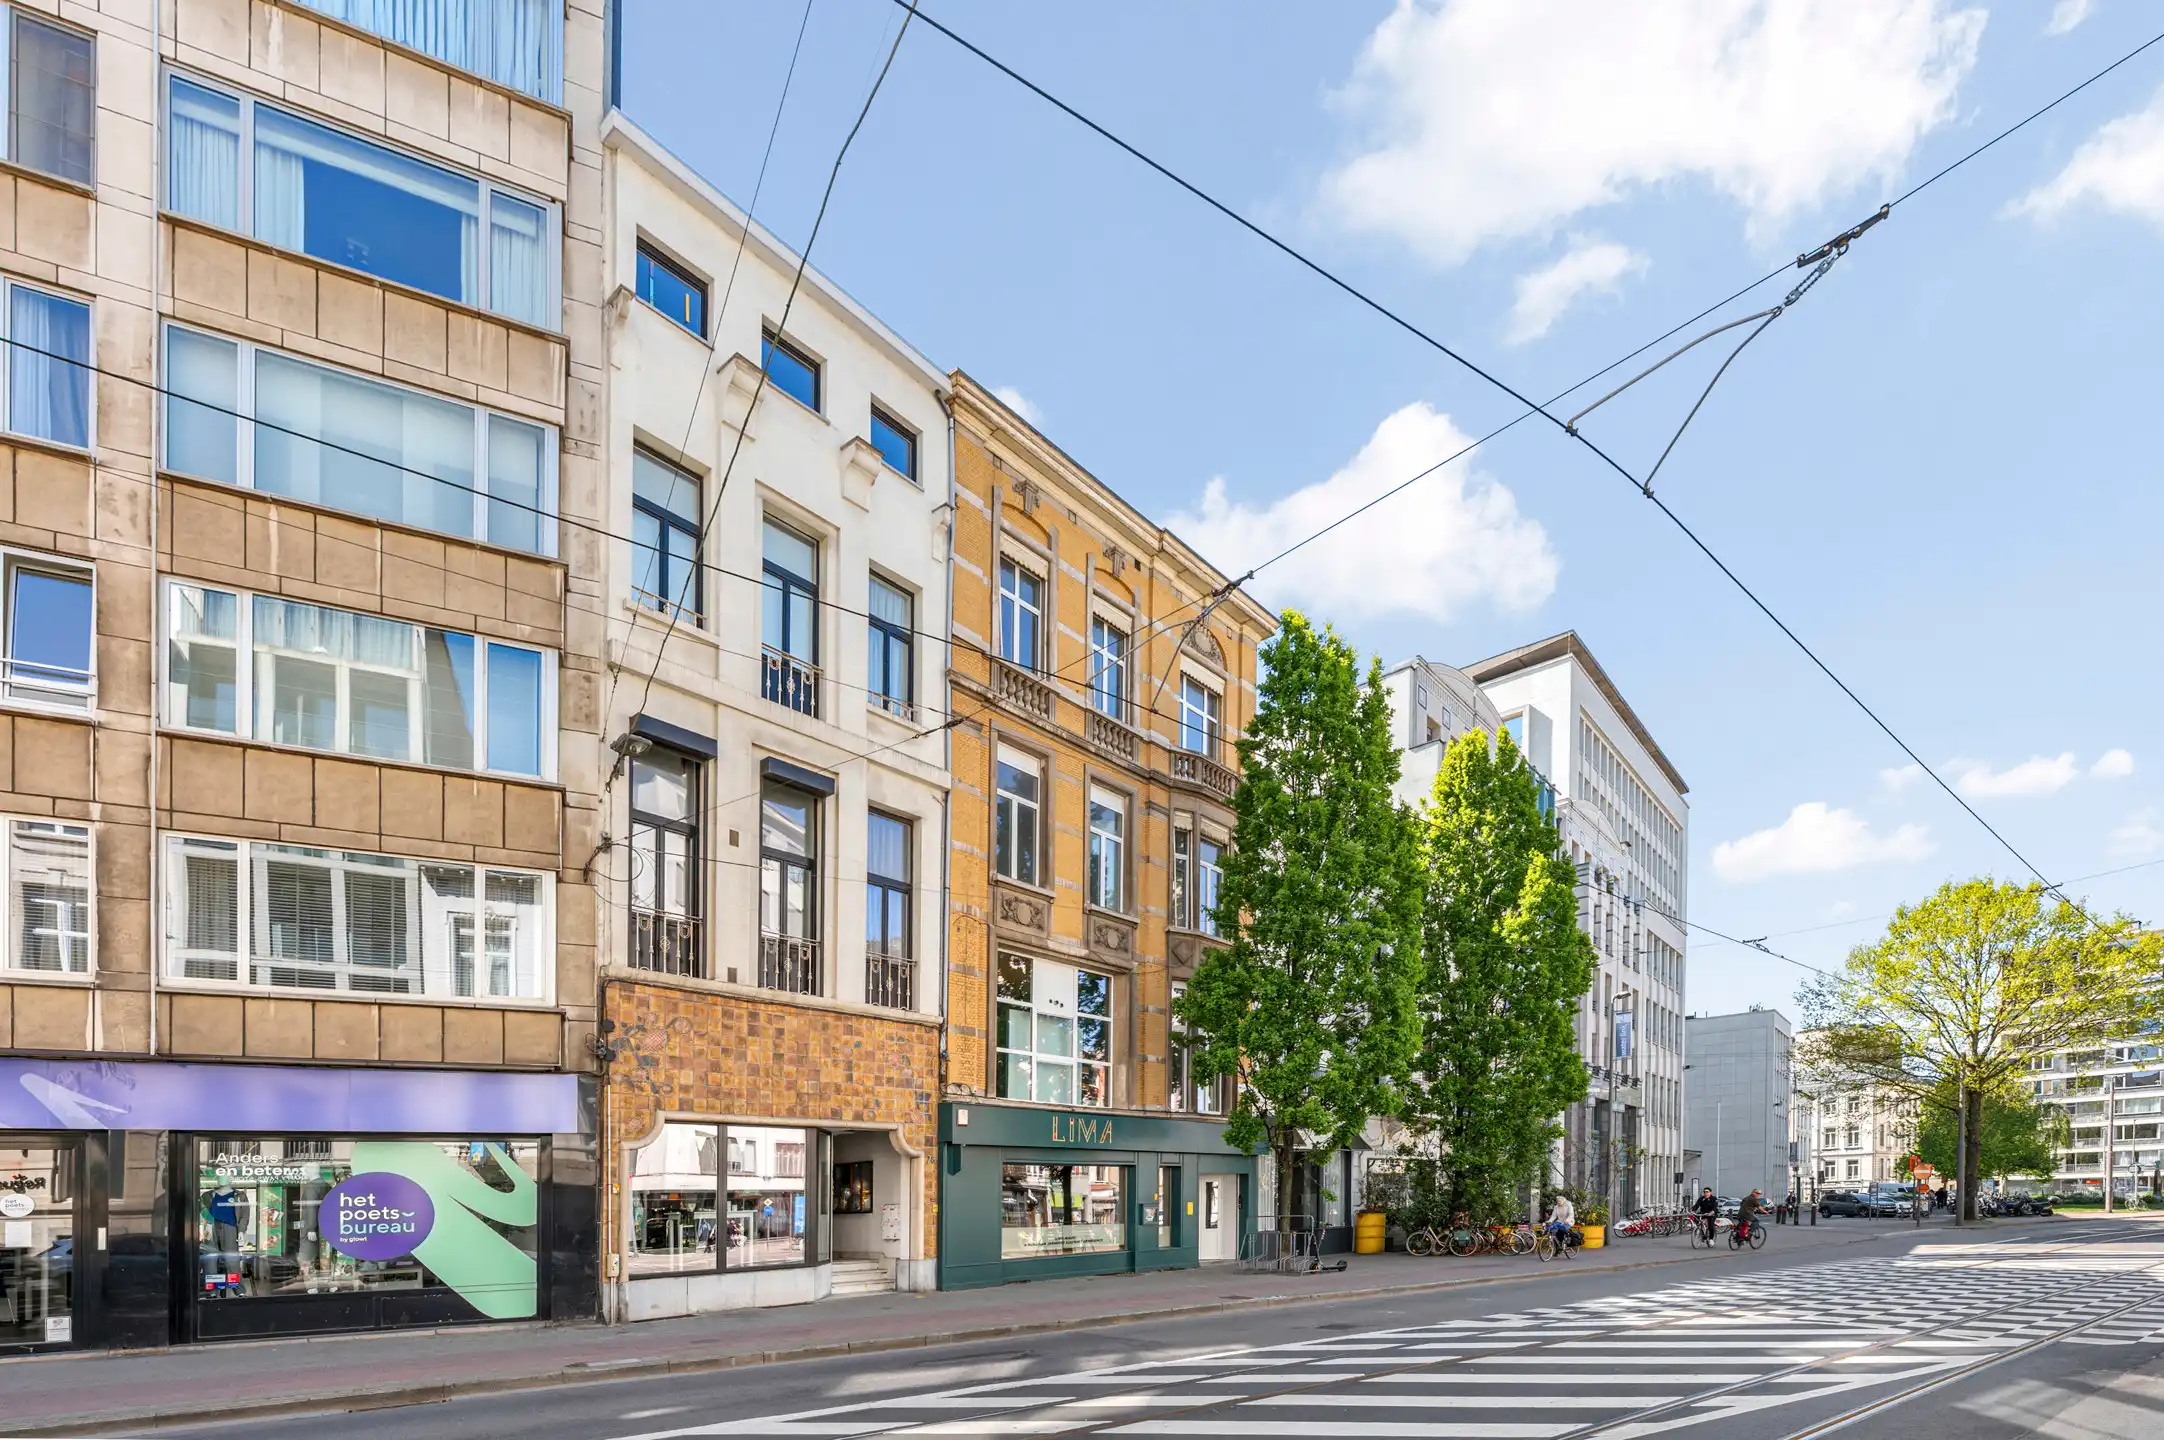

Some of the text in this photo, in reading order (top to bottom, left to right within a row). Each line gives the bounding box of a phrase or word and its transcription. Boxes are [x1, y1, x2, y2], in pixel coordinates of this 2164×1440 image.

[1052, 1115, 1113, 1144] LIMA
[215, 1152, 279, 1163] Anders
[215, 1167, 238, 1176] en
[340, 1192, 376, 1207] het
[340, 1220, 415, 1235] bureau
